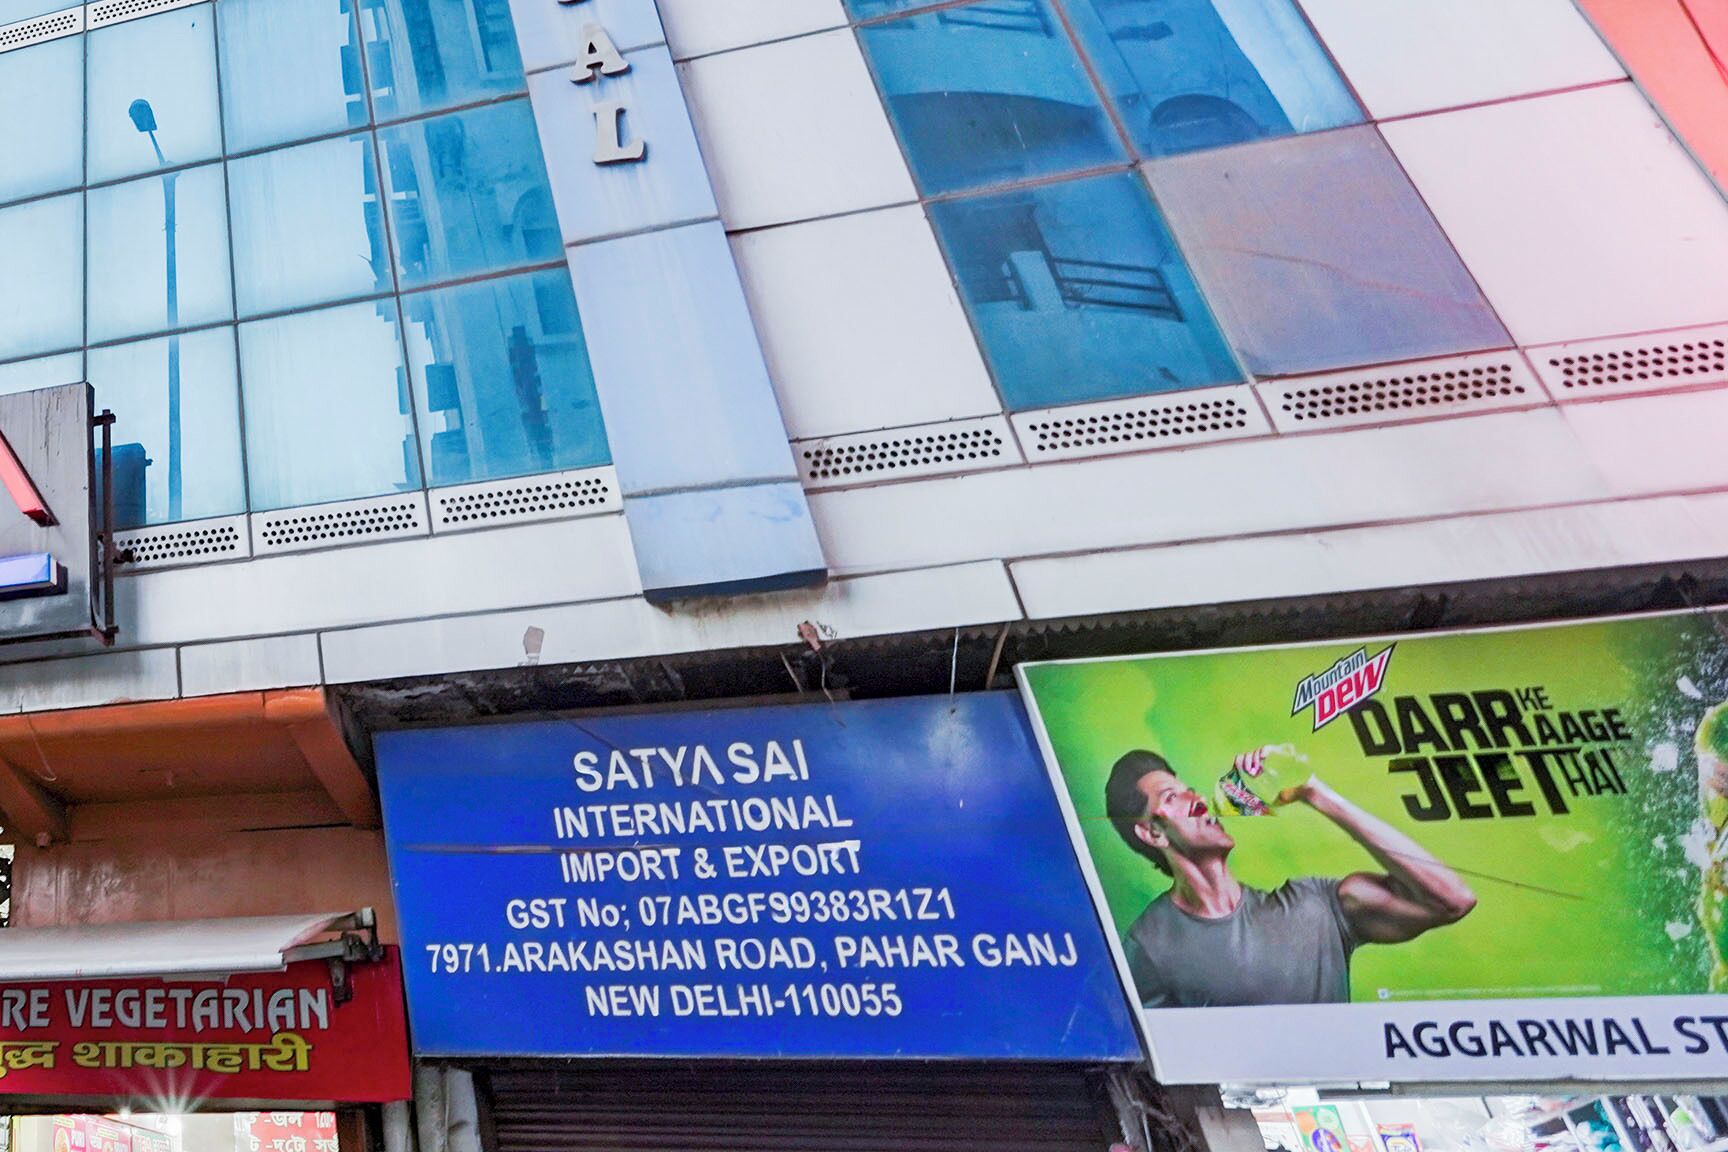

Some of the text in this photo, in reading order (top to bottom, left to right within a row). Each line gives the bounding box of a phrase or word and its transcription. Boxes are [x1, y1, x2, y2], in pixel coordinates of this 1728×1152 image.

[1294, 650, 1366, 708] Mountain
[1349, 686, 1632, 757] DARR KE AAGE
[573, 739, 810, 792] SATYA SAI
[1388, 747, 1580, 822] JEET
[553, 794, 853, 839] INTERNATIONAL
[560, 840, 861, 883] IMPORT & EXPORT
[506, 898, 567, 929] GST
[638, 887, 956, 927] 07ABGF99383R1Z1
[714, 937, 828, 974] ROAD,
[834, 933, 966, 969] PAHAR
[972, 932, 1078, 968] GANJ
[65, 988, 330, 1034] VEGETARIAN
[585, 983, 903, 1017] NEW DELHI-110055
[72, 1032, 313, 1073] शाकाहारी
[1383, 1017, 1671, 1058] AGGARWAL
